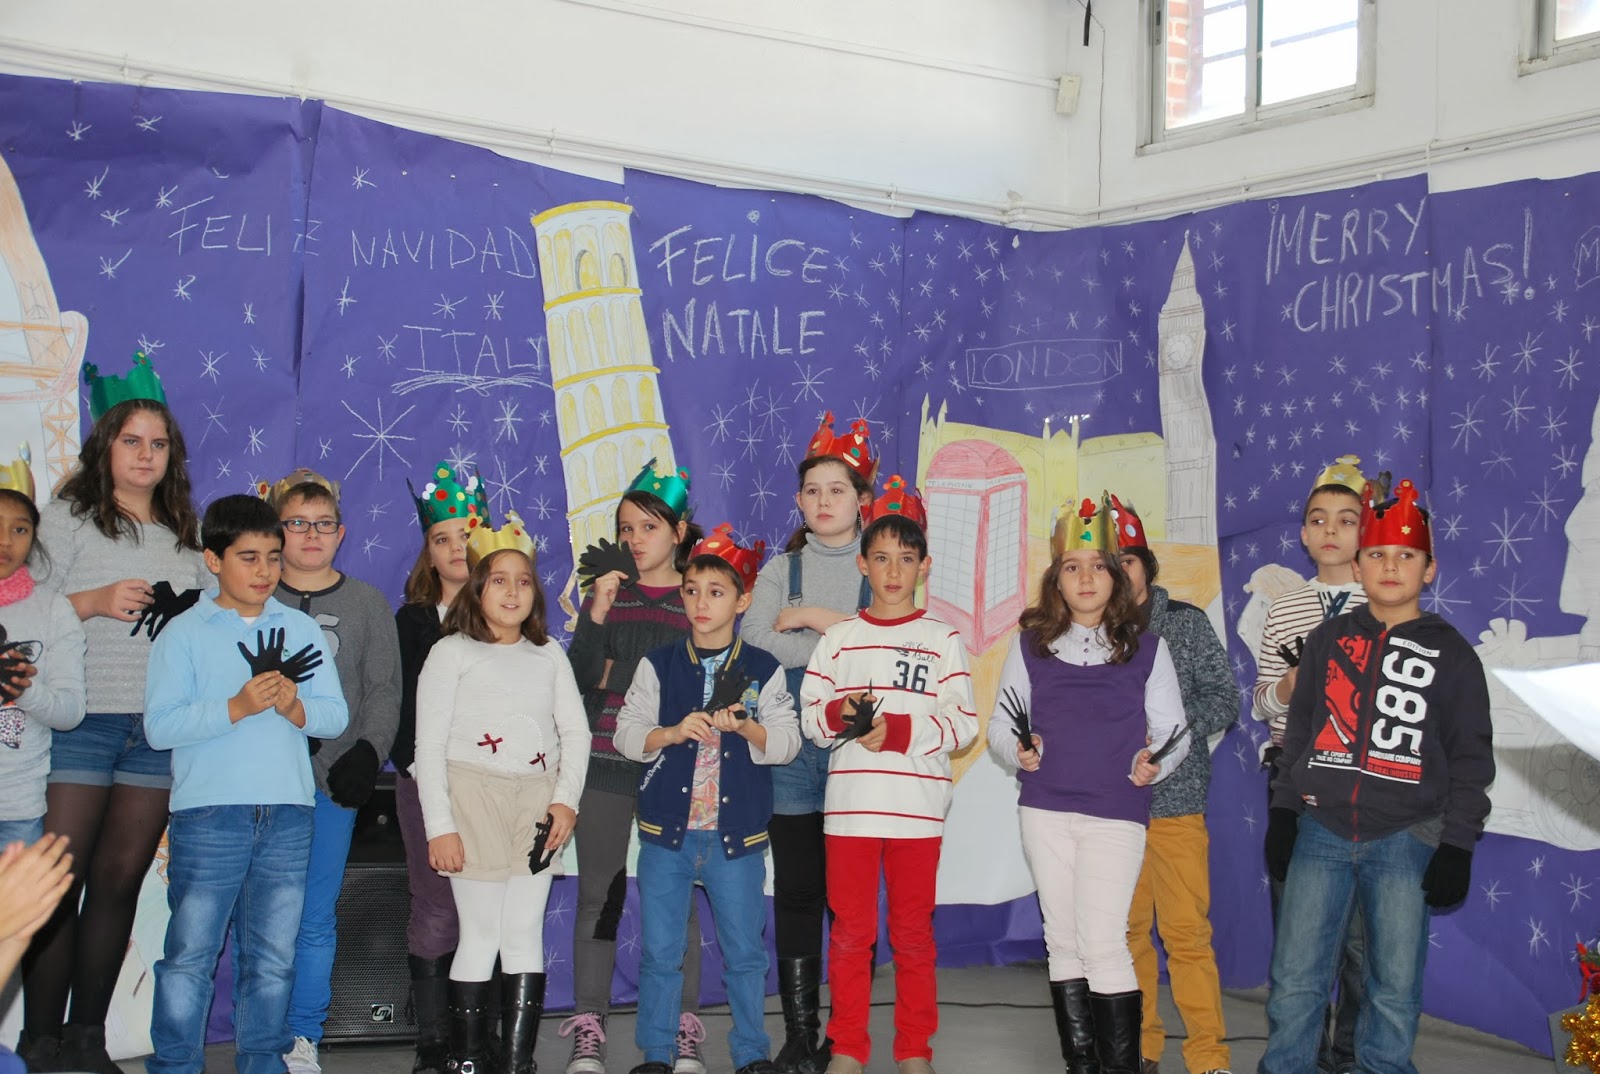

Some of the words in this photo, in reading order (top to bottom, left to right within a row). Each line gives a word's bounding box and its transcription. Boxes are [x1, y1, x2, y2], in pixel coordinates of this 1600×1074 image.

[168, 196, 322, 256] FELIZ
[351, 226, 537, 279] NAVIDAD
[649, 210, 829, 287] FELICE
[1294, 207, 1534, 332] CHRISTMAS!
[402, 324, 543, 377] ITALY
[662, 297, 826, 359] NATALE
[972, 345, 1119, 384] LONDON
[1402, 640, 1432, 655] EDITION
[892, 660, 929, 694] 36
[1395, 754, 1421, 766] COMPANY
